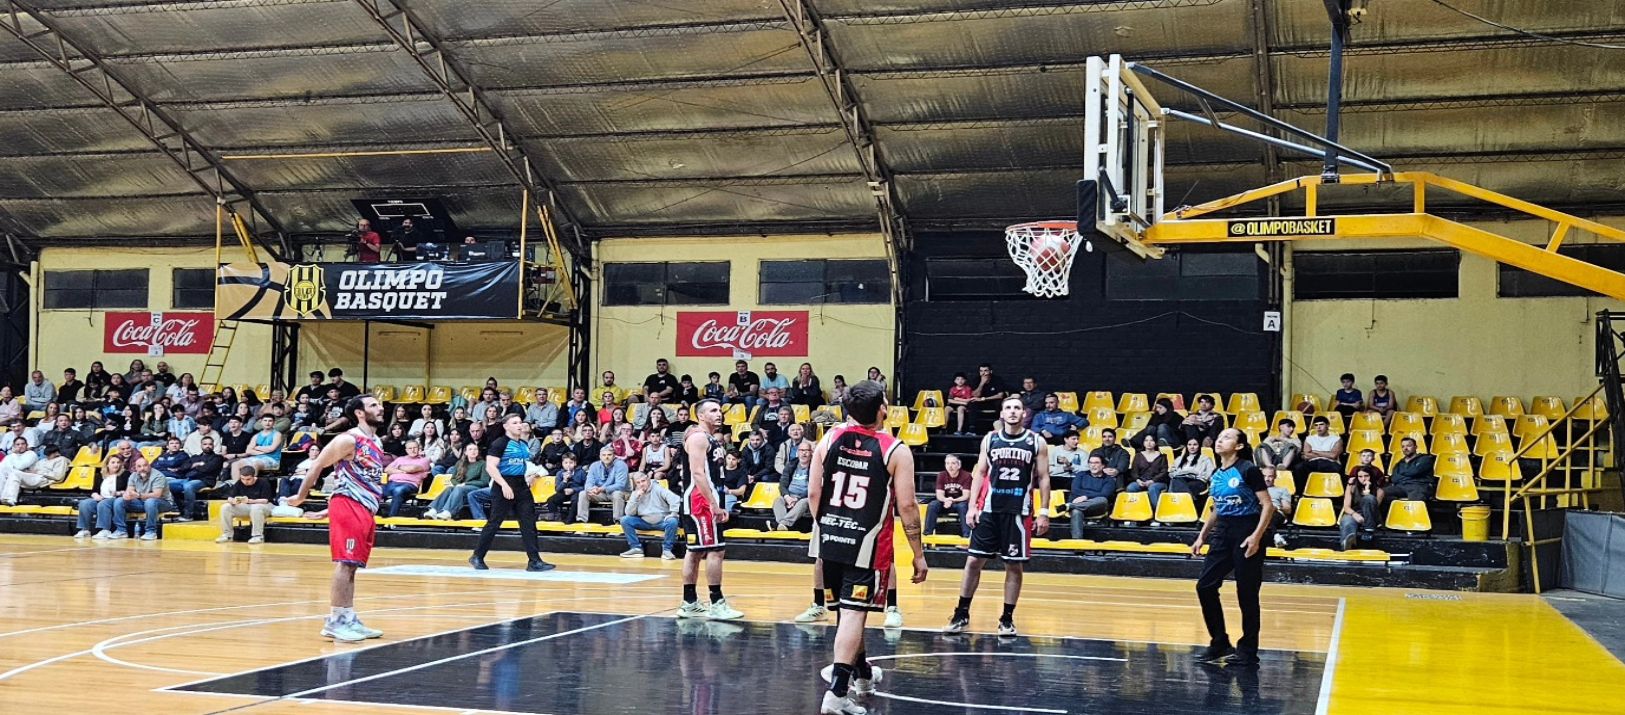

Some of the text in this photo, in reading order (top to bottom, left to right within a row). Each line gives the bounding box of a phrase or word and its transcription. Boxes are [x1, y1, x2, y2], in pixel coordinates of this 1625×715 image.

[1230, 219, 1332, 235] @OLIMPOBASKET
[338, 269, 444, 290] OLIMPO
[334, 291, 447, 312] BASQUET
[1267, 319, 1276, 328] A
[837, 456, 869, 471] ESCOBAR
[990, 447, 1033, 464] SPORTIVO
[998, 467, 1021, 481] 22
[829, 471, 870, 510] 15
